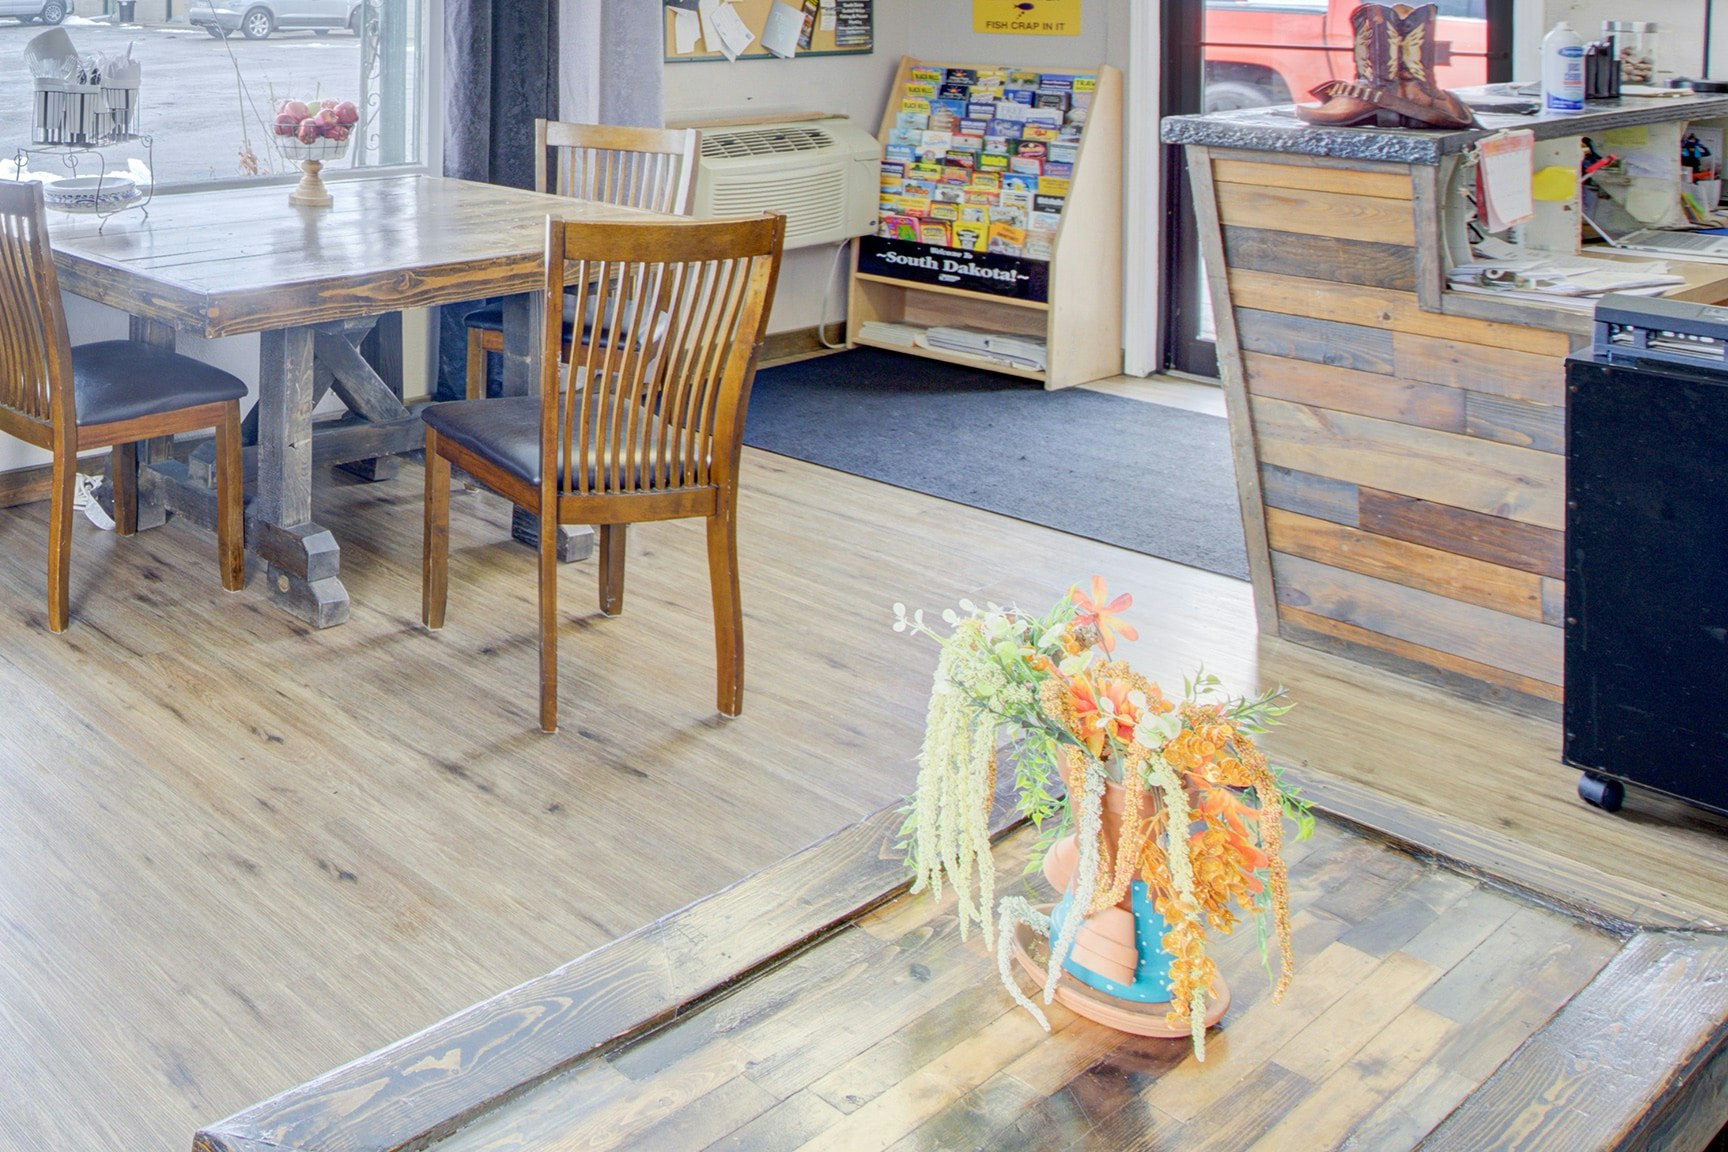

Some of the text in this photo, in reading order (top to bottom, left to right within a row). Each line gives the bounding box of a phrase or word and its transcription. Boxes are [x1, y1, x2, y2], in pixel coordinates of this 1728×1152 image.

[986, 21, 1065, 30] FISH CRAP IN IT
